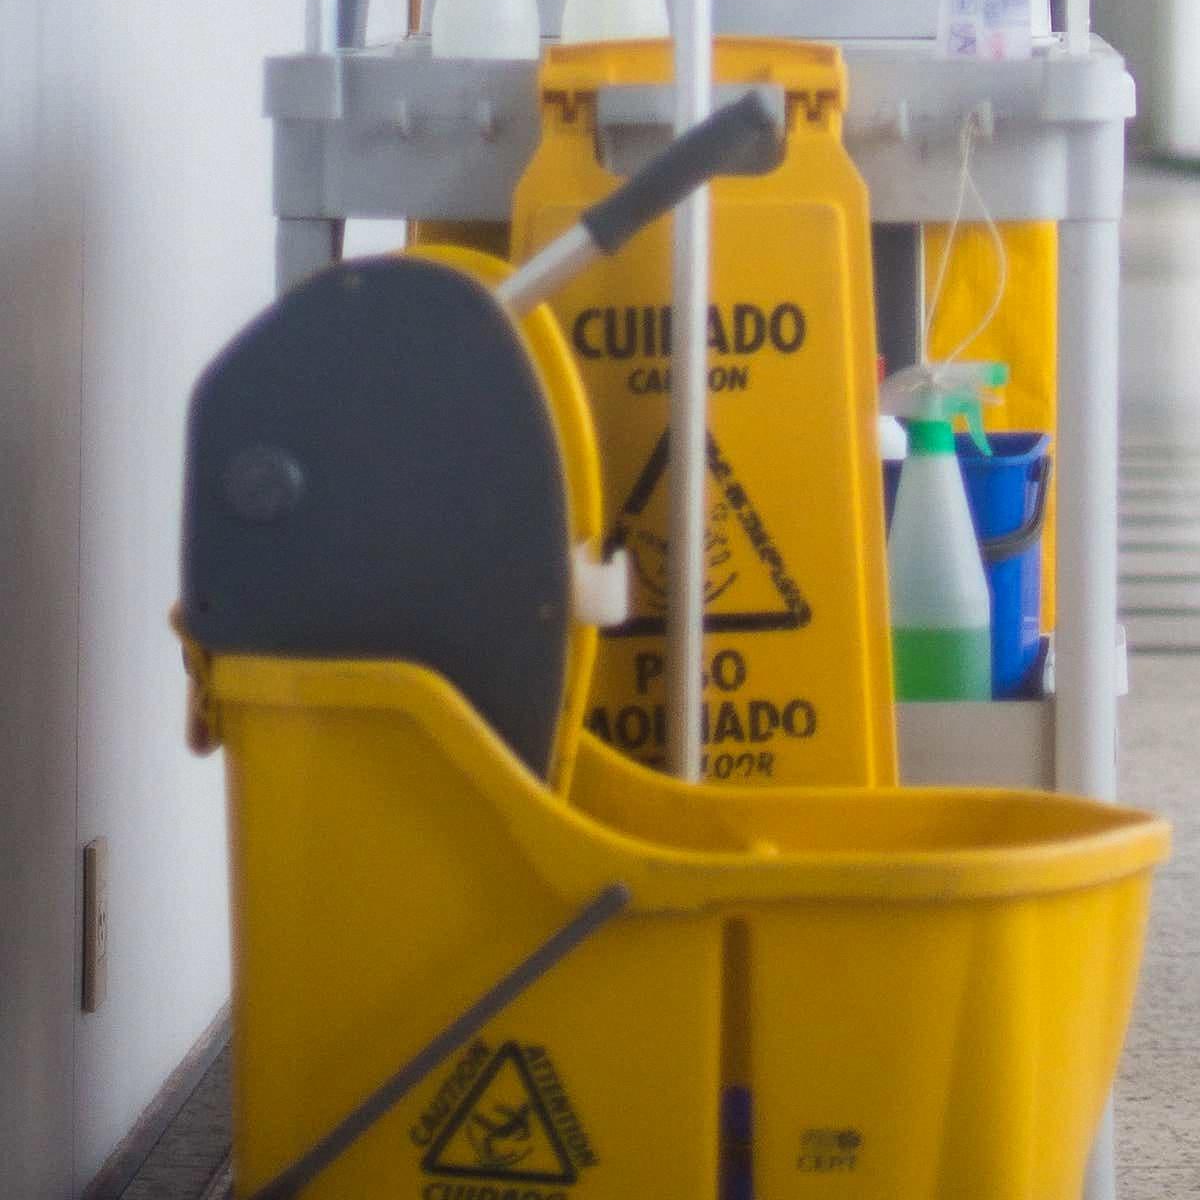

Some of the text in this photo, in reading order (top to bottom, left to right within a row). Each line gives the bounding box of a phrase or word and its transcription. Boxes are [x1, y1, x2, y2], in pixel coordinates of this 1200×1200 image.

[572, 302, 807, 358] CUIADO
[627, 366, 749, 396] CAON
[523, 1046, 600, 1167] ATTENTION
